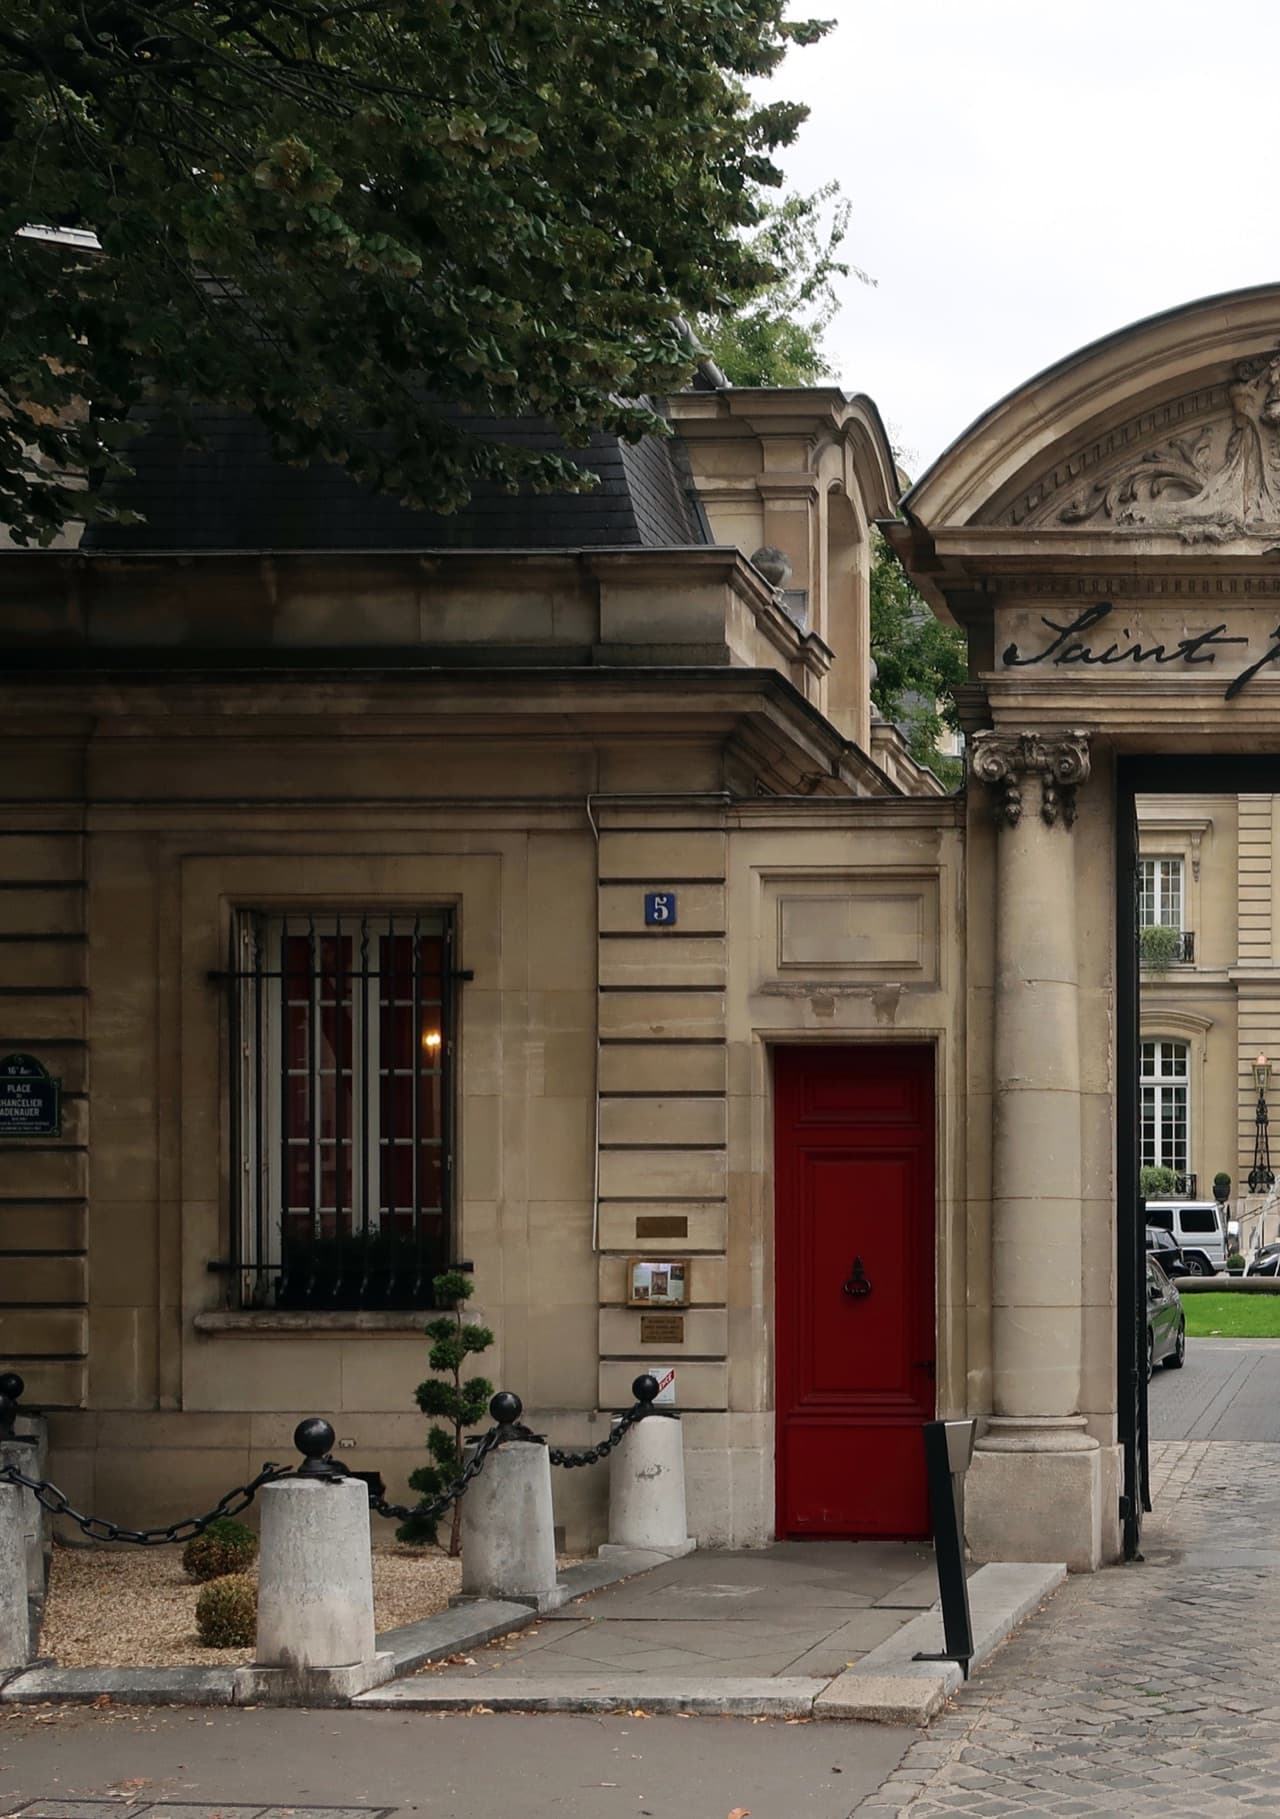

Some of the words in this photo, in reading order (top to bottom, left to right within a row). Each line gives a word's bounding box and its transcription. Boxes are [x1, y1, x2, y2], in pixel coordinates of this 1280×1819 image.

[1002, 602, 1249, 667] Saint
[653, 896, 669, 921] 5
[7, 1084, 31, 1093] PLACE
[0, 1098, 43, 1107] HANCELIER
[0, 1107, 40, 1117] ADENAUER
